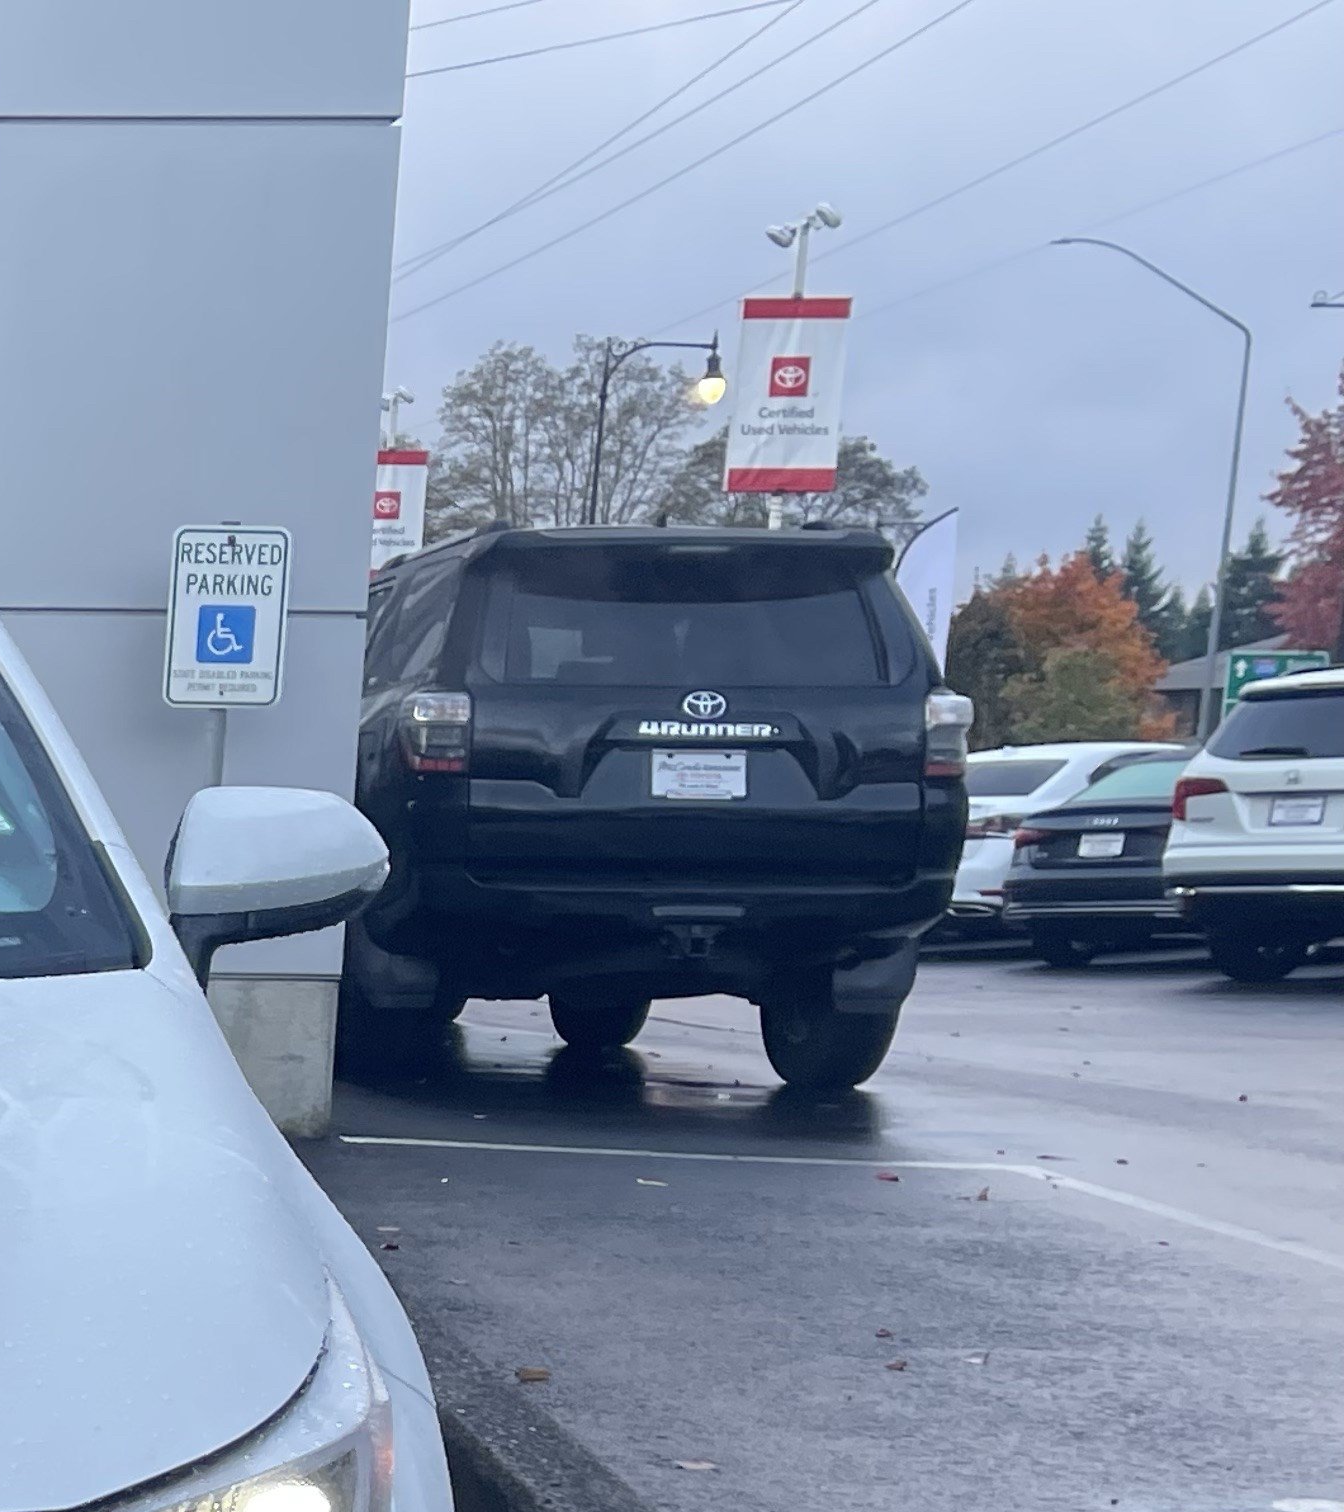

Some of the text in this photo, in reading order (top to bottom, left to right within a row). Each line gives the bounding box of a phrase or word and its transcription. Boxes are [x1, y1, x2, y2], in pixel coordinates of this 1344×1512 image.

[740, 424, 774, 436] Used
[180, 542, 283, 566] RESERVED
[185, 573, 273, 597] PARKING
